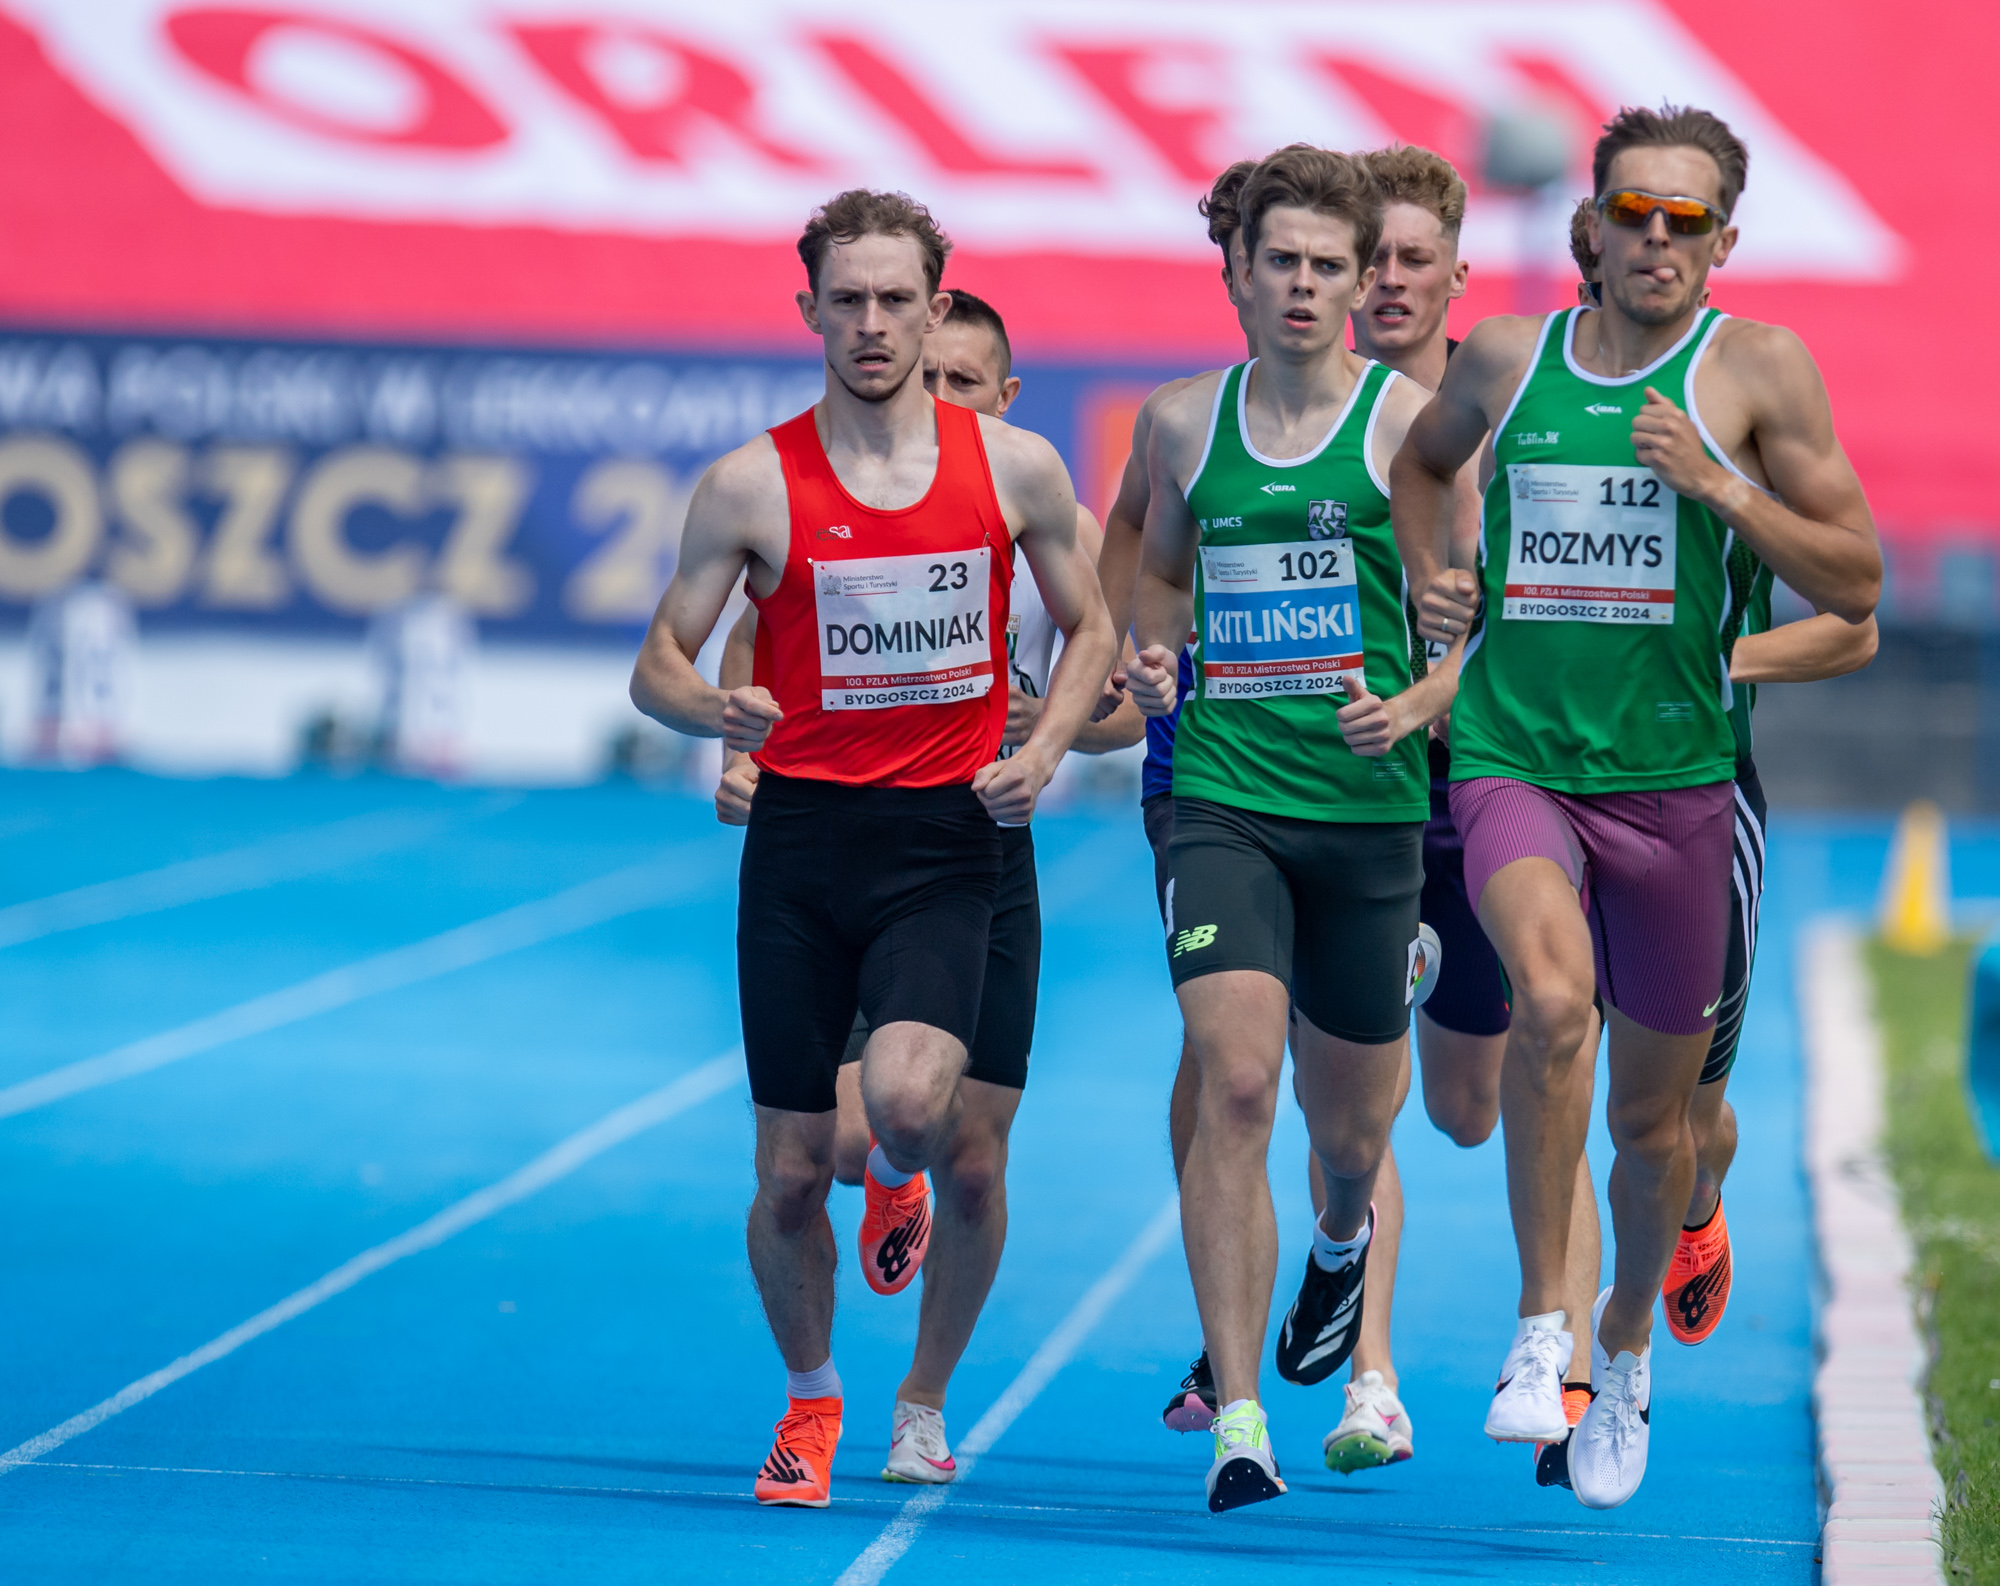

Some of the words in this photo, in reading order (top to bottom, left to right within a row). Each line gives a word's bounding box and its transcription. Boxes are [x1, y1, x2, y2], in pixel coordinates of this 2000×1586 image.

[1599, 476, 1661, 508] 112
[0, 434, 532, 612] OSZCZ
[566, 460, 690, 616] 2
[1212, 516, 1243, 529] UMCS
[1519, 530, 1663, 568] ROZMYS
[1278, 549, 1340, 582] 102
[843, 573, 884, 583] Ministerstwo
[843, 581, 865, 591] Sportu
[869, 580, 898, 589] Turystyki
[928, 561, 968, 593] 23
[1523, 586, 1539, 596] 100.
[1540, 587, 1559, 597] PZLA
[1560, 587, 1619, 599] Mistrzostwa
[1620, 590, 1650, 600] Polski
[1519, 603, 1608, 618] BYDGOSZCZ
[1611, 606, 1650, 619] 2024
[825, 609, 985, 656] DOMINIAK
[1208, 600, 1354, 645] KITLIŃSKI
[845, 677, 865, 687] 100.
[866, 677, 889, 686] PZLA
[890, 672, 948, 685] Mistrzostwa
[948, 666, 972, 679] Polski
[1222, 665, 1236, 675] 100.
[1236, 664, 1253, 675] PZLA
[1254, 662, 1311, 674] Mistrzostwa
[1312, 658, 1341, 670] Polski
[844, 689, 939, 706] BYDGOSZCZ
[942, 682, 975, 699] 2024
[1219, 679, 1302, 694] BYDGOSZCZ
[1306, 675, 1344, 690] 2024
